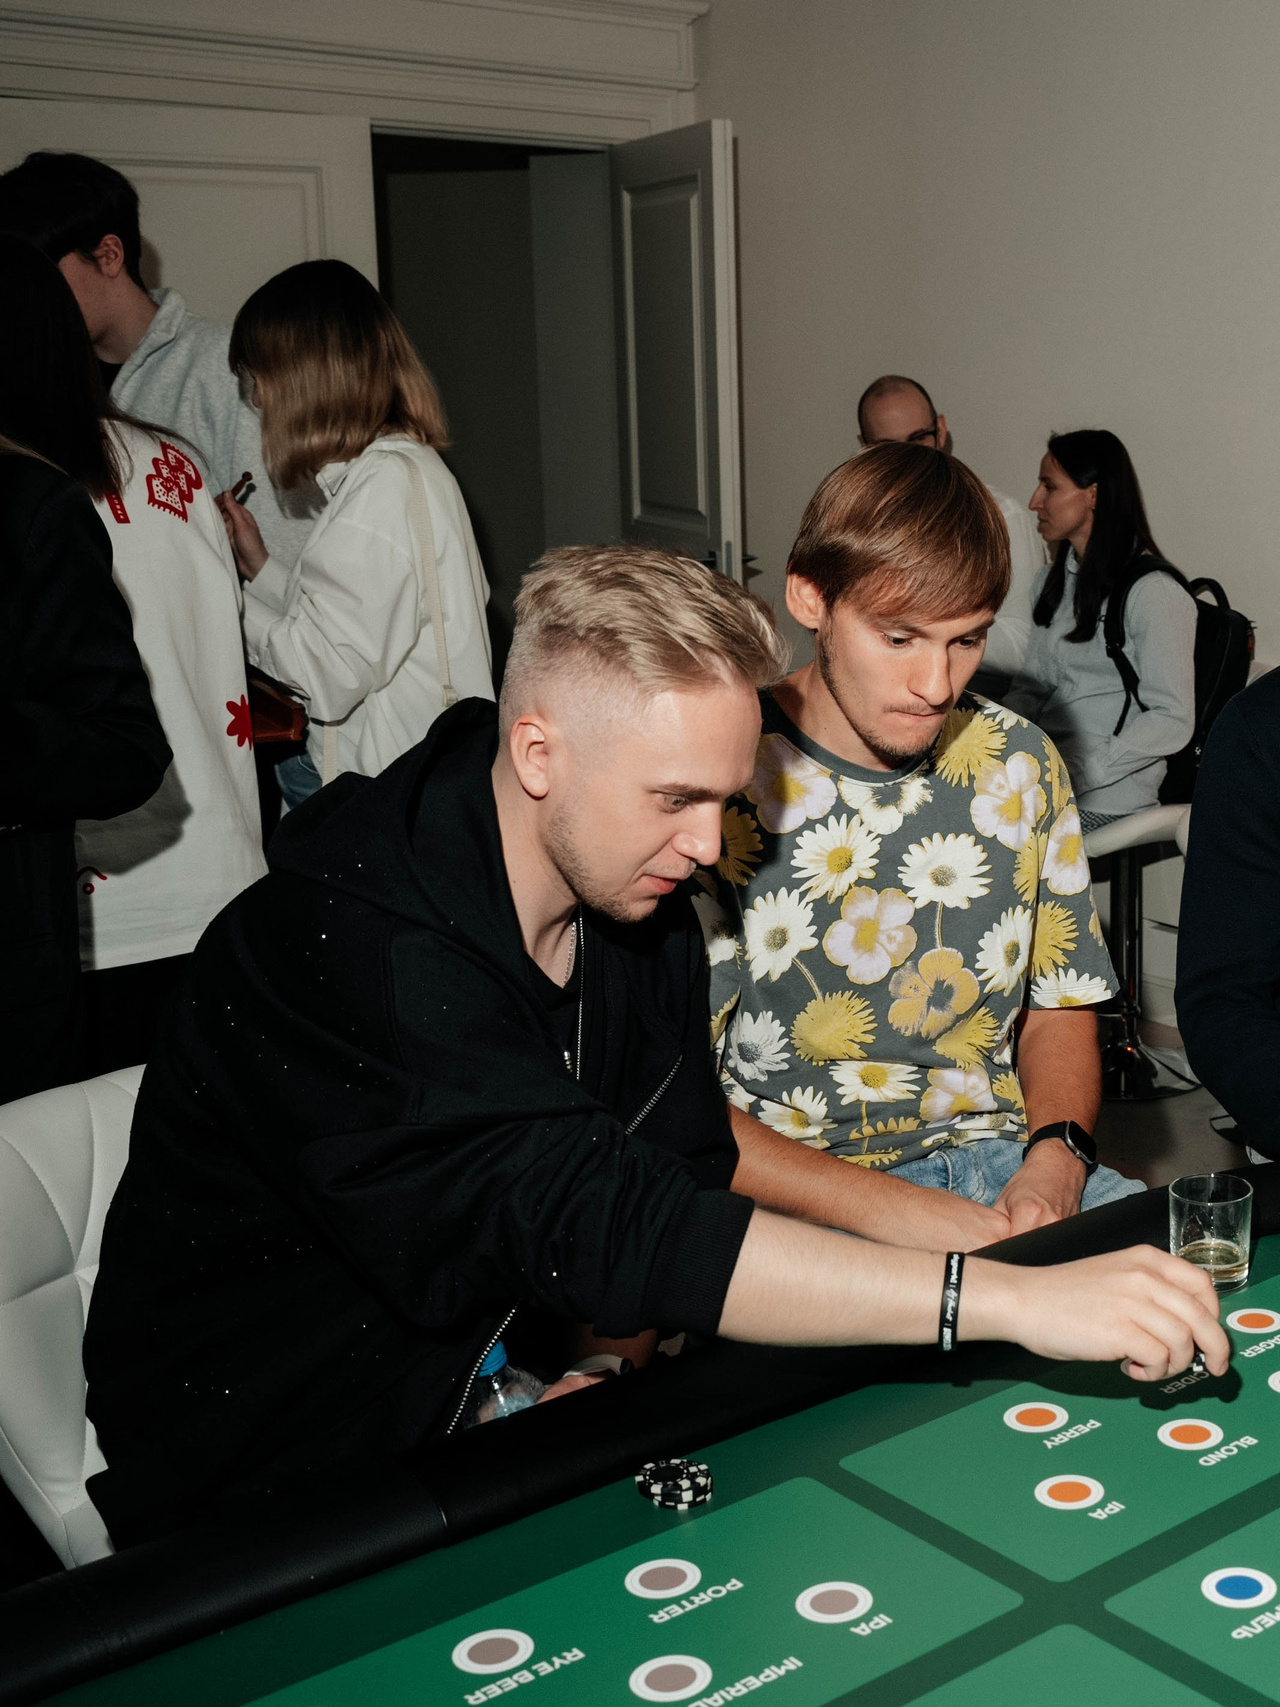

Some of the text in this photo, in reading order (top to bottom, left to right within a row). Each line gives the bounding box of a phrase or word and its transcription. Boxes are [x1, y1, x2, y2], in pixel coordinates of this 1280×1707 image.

[1158, 1371, 1210, 1394] CIDER
[1042, 1418, 1102, 1450] PERRY
[1198, 1435, 1259, 1466] BLOND
[1087, 1500, 1126, 1520] IPA
[647, 1578, 745, 1624] PORTER
[849, 1613, 894, 1638] IPA
[463, 1647, 586, 1705] RYE BEER
